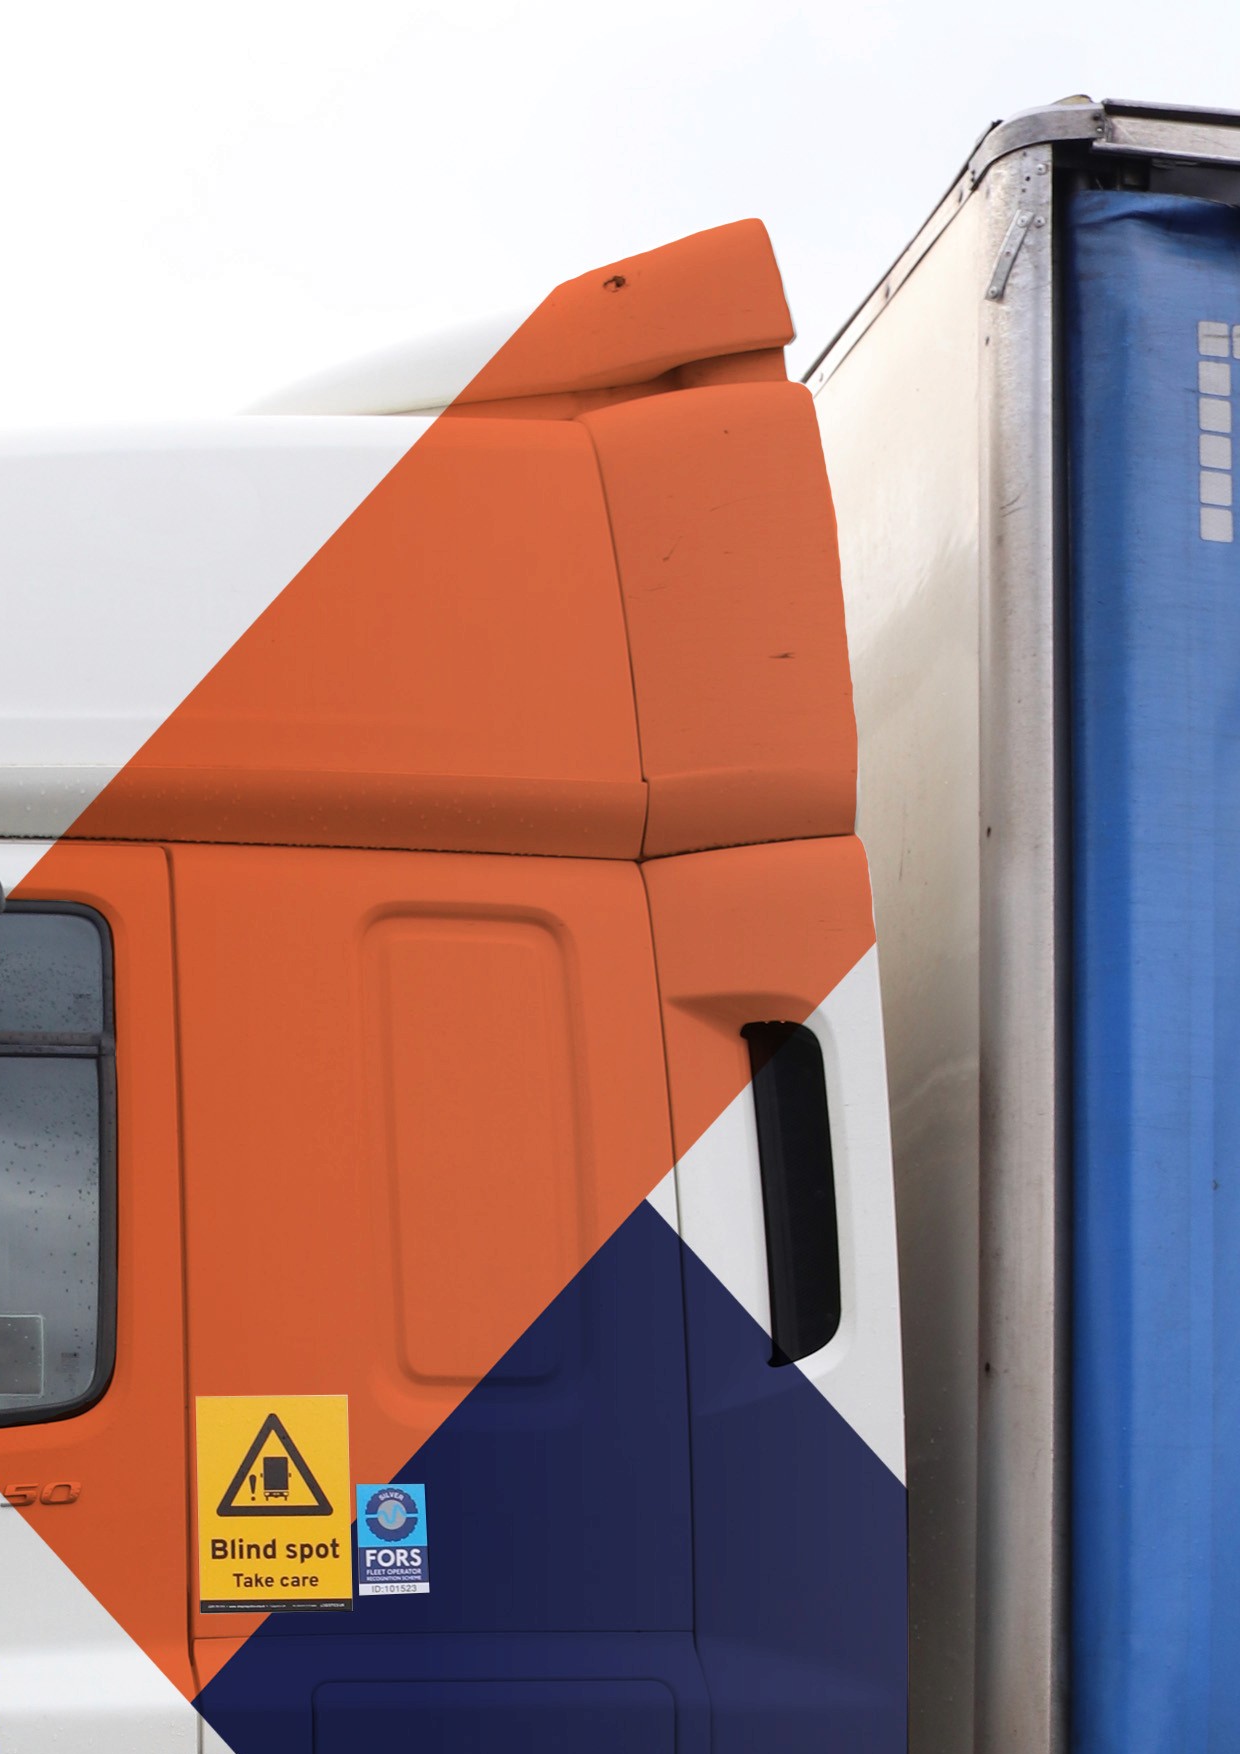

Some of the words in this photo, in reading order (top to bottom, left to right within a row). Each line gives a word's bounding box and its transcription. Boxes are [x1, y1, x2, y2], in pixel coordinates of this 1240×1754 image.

[378, 1491, 405, 1501] SILVER
[211, 1538, 277, 1560] Blind
[285, 1538, 340, 1564] spot
[365, 1548, 422, 1567] FORS
[233, 1573, 274, 1588] Take
[279, 1575, 319, 1588] care
[371, 1584, 418, 1593] ID:101523
